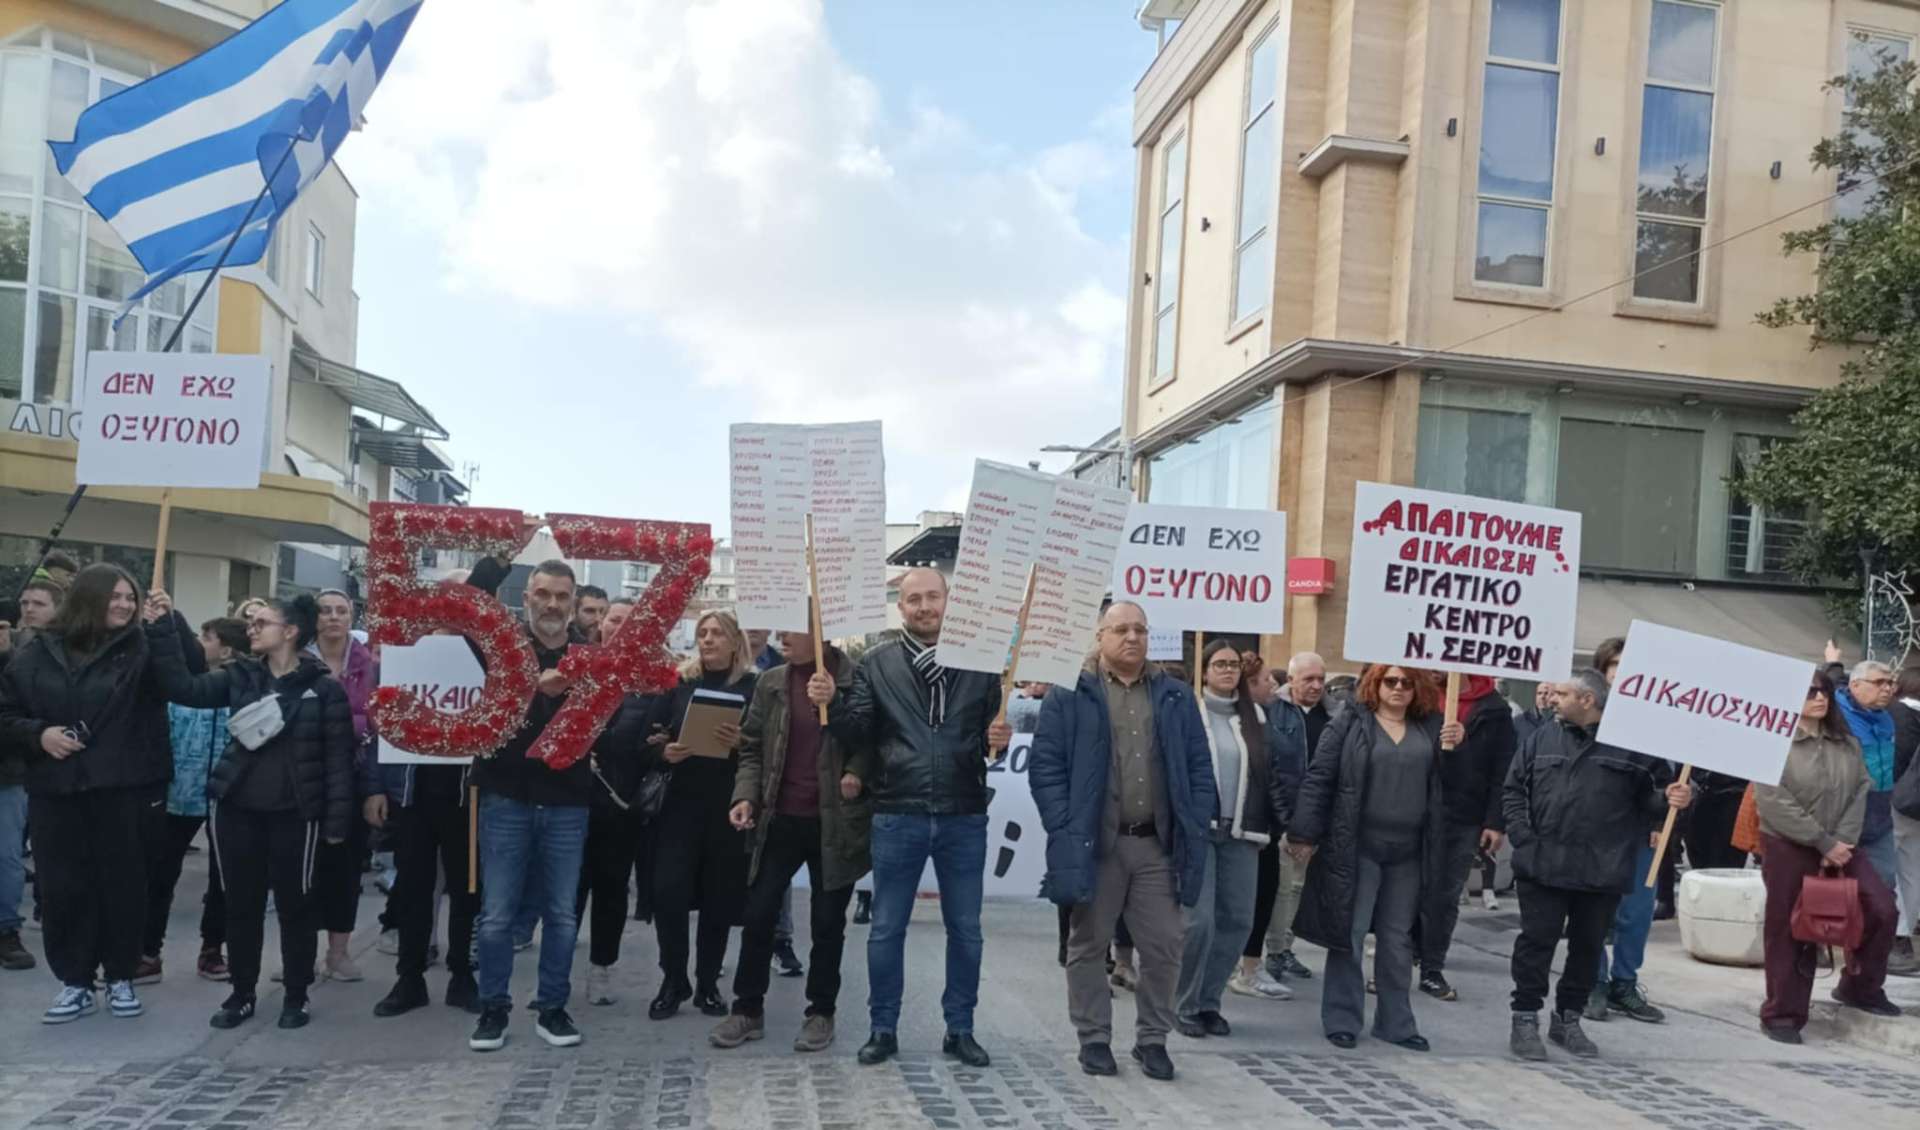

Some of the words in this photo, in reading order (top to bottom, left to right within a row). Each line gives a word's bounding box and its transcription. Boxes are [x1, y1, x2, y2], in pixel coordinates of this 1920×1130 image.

[102, 372, 154, 395] ΔΕΝ
[181, 376, 235, 398] ΕΧΩ
[101, 414, 240, 446] ΟΞΥΓΟΝΟ
[1129, 523, 1186, 546] ΔΕΝ
[1208, 527, 1261, 551] ΕΧΩ
[1378, 499, 1563, 552] ΑΠΑΙΤΟΥΜΕ
[1399, 537, 1537, 576] ΔΙΚΑΙΩΣΗ
[1125, 564, 1272, 603] ΟΞΥΓΟΝΟ
[1384, 563, 1522, 606] ΕΡΓΑΤΙΚΟ
[366, 501, 714, 770] 57
[1425, 603, 1531, 640] ΚΕΝΤΡΟ
[1404, 632, 1433, 659] Ν.
[1440, 636, 1543, 672] ΣΕΡΡΩΝ
[1618, 673, 1799, 738] ΔΙΚΑΙΟΣΥΝΗ
